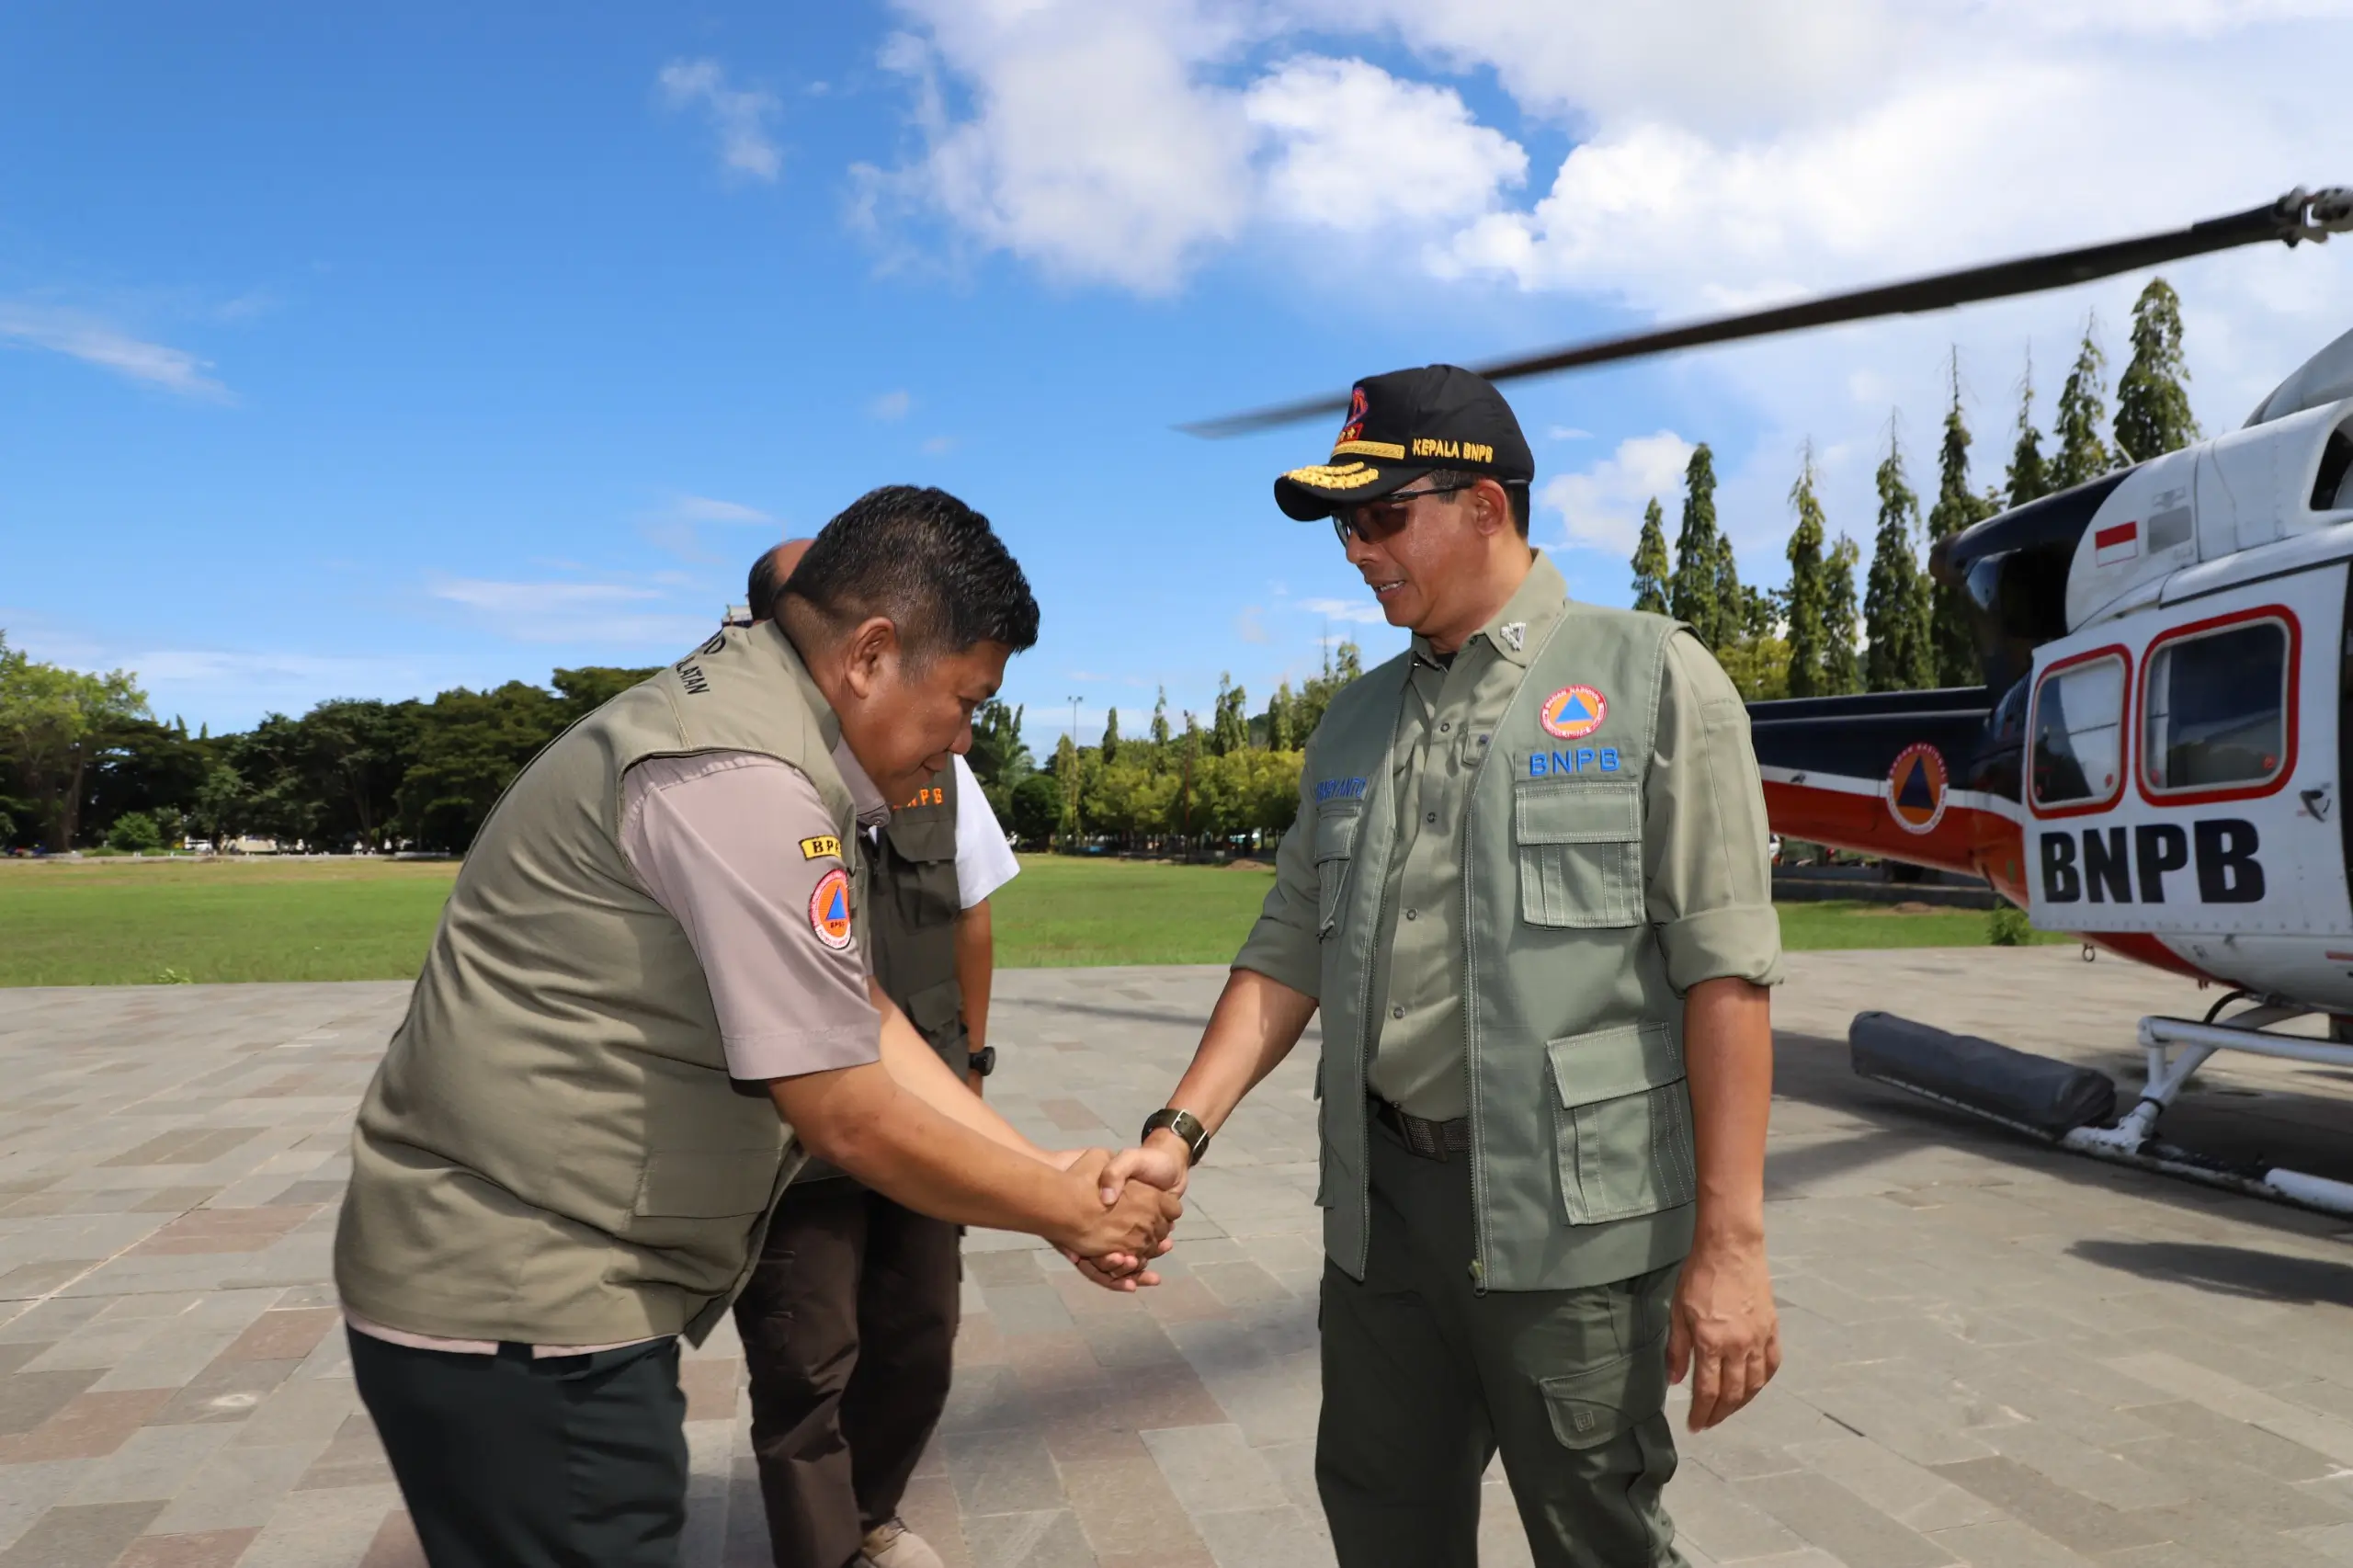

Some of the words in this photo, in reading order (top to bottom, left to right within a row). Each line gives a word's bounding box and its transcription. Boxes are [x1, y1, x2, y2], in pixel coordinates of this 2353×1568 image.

[1412, 438, 1460, 459] KEPALA
[1462, 441, 1495, 463] BNPB
[676, 655, 710, 695] LATAN
[1530, 748, 1620, 776] BNPB
[2040, 818, 2267, 904] BNPB
